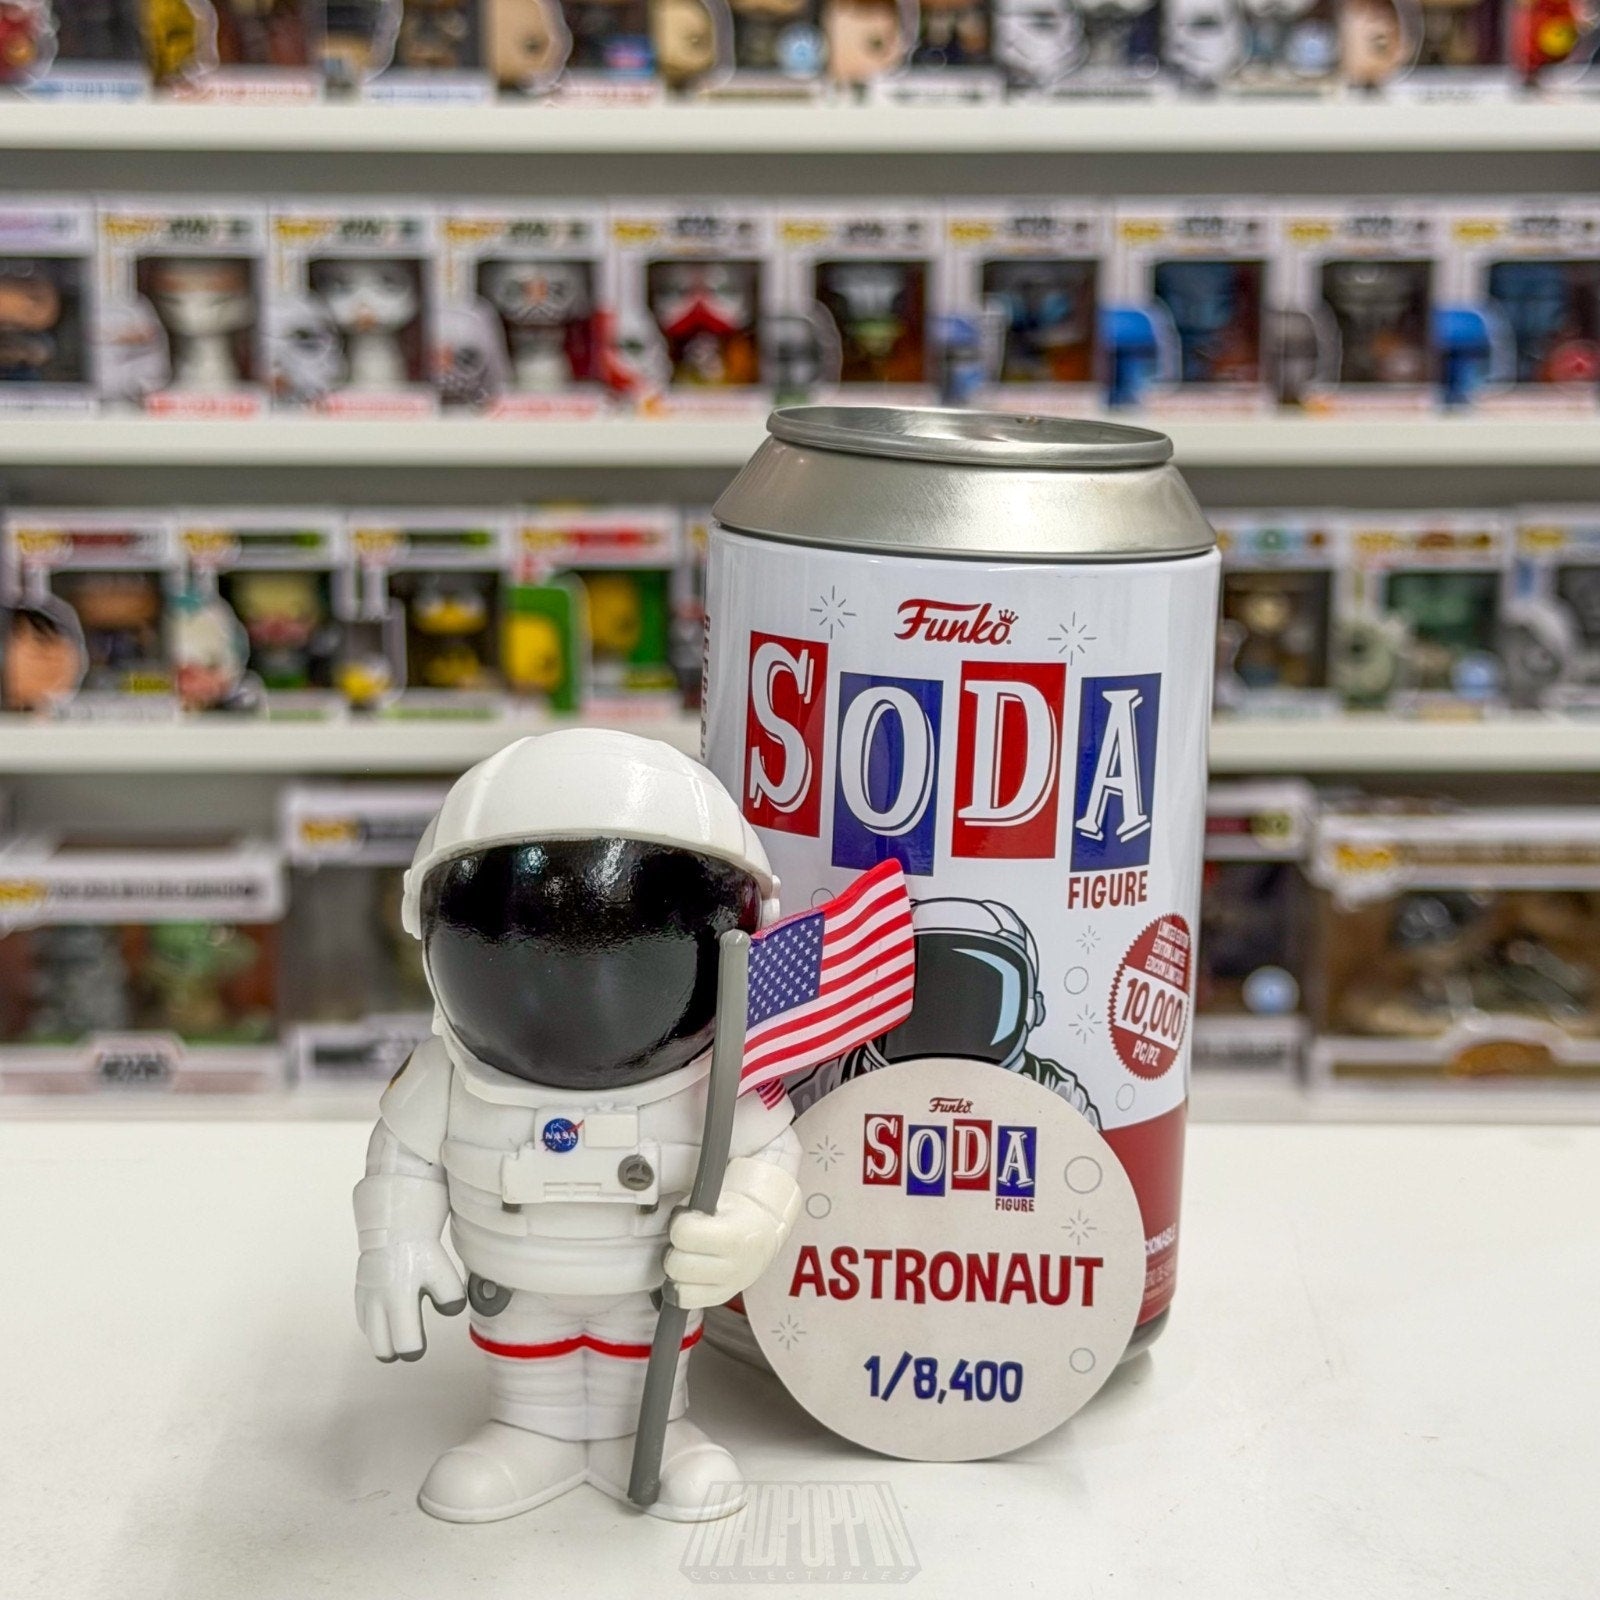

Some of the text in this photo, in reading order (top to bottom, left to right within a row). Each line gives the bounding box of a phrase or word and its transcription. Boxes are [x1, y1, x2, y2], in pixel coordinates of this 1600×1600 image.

[894, 598, 1019, 645] Funko
[747, 638, 1153, 844] SODA
[1068, 871, 1148, 910] FIGURE
[1122, 978, 1183, 1041] 10,000
[929, 1097, 972, 1114] Funko
[545, 1131, 577, 1141] NASA
[864, 1115, 1035, 1189] SODA
[995, 1198, 1035, 1212] FIGURE
[789, 1245, 1104, 1307] ASTRONAUT
[863, 1351, 1024, 1404] 1/8,400
